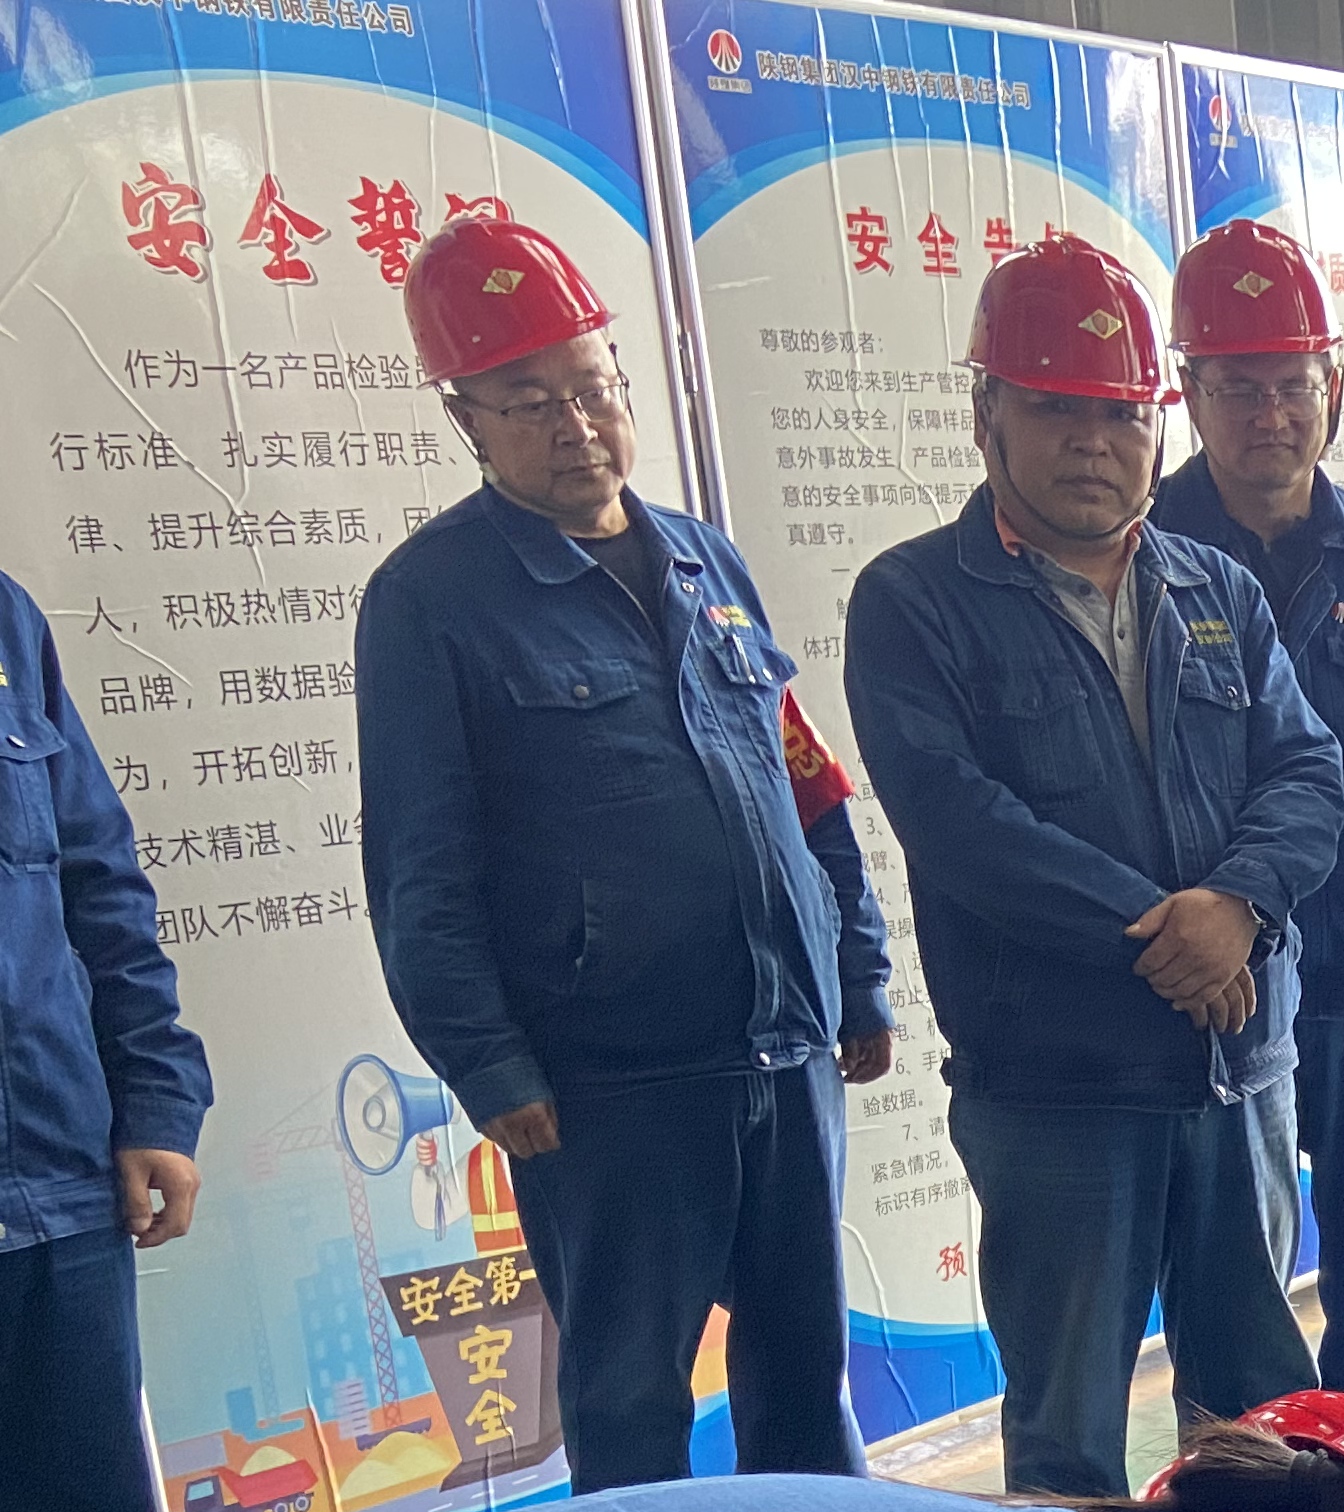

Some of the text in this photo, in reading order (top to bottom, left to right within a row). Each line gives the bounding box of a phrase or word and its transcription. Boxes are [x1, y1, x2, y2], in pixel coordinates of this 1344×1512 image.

[122, 162, 509, 288] 安全誓
[846, 206, 1062, 277] 安全告
[65, 505, 442, 554] 律、提升综合素质，团
[782, 481, 976, 508] 意的安全事项向您提示
[888, 985, 931, 1010] 防止
[400, 1256, 537, 1326] 安全第一
[458, 1324, 517, 1446] 安全
